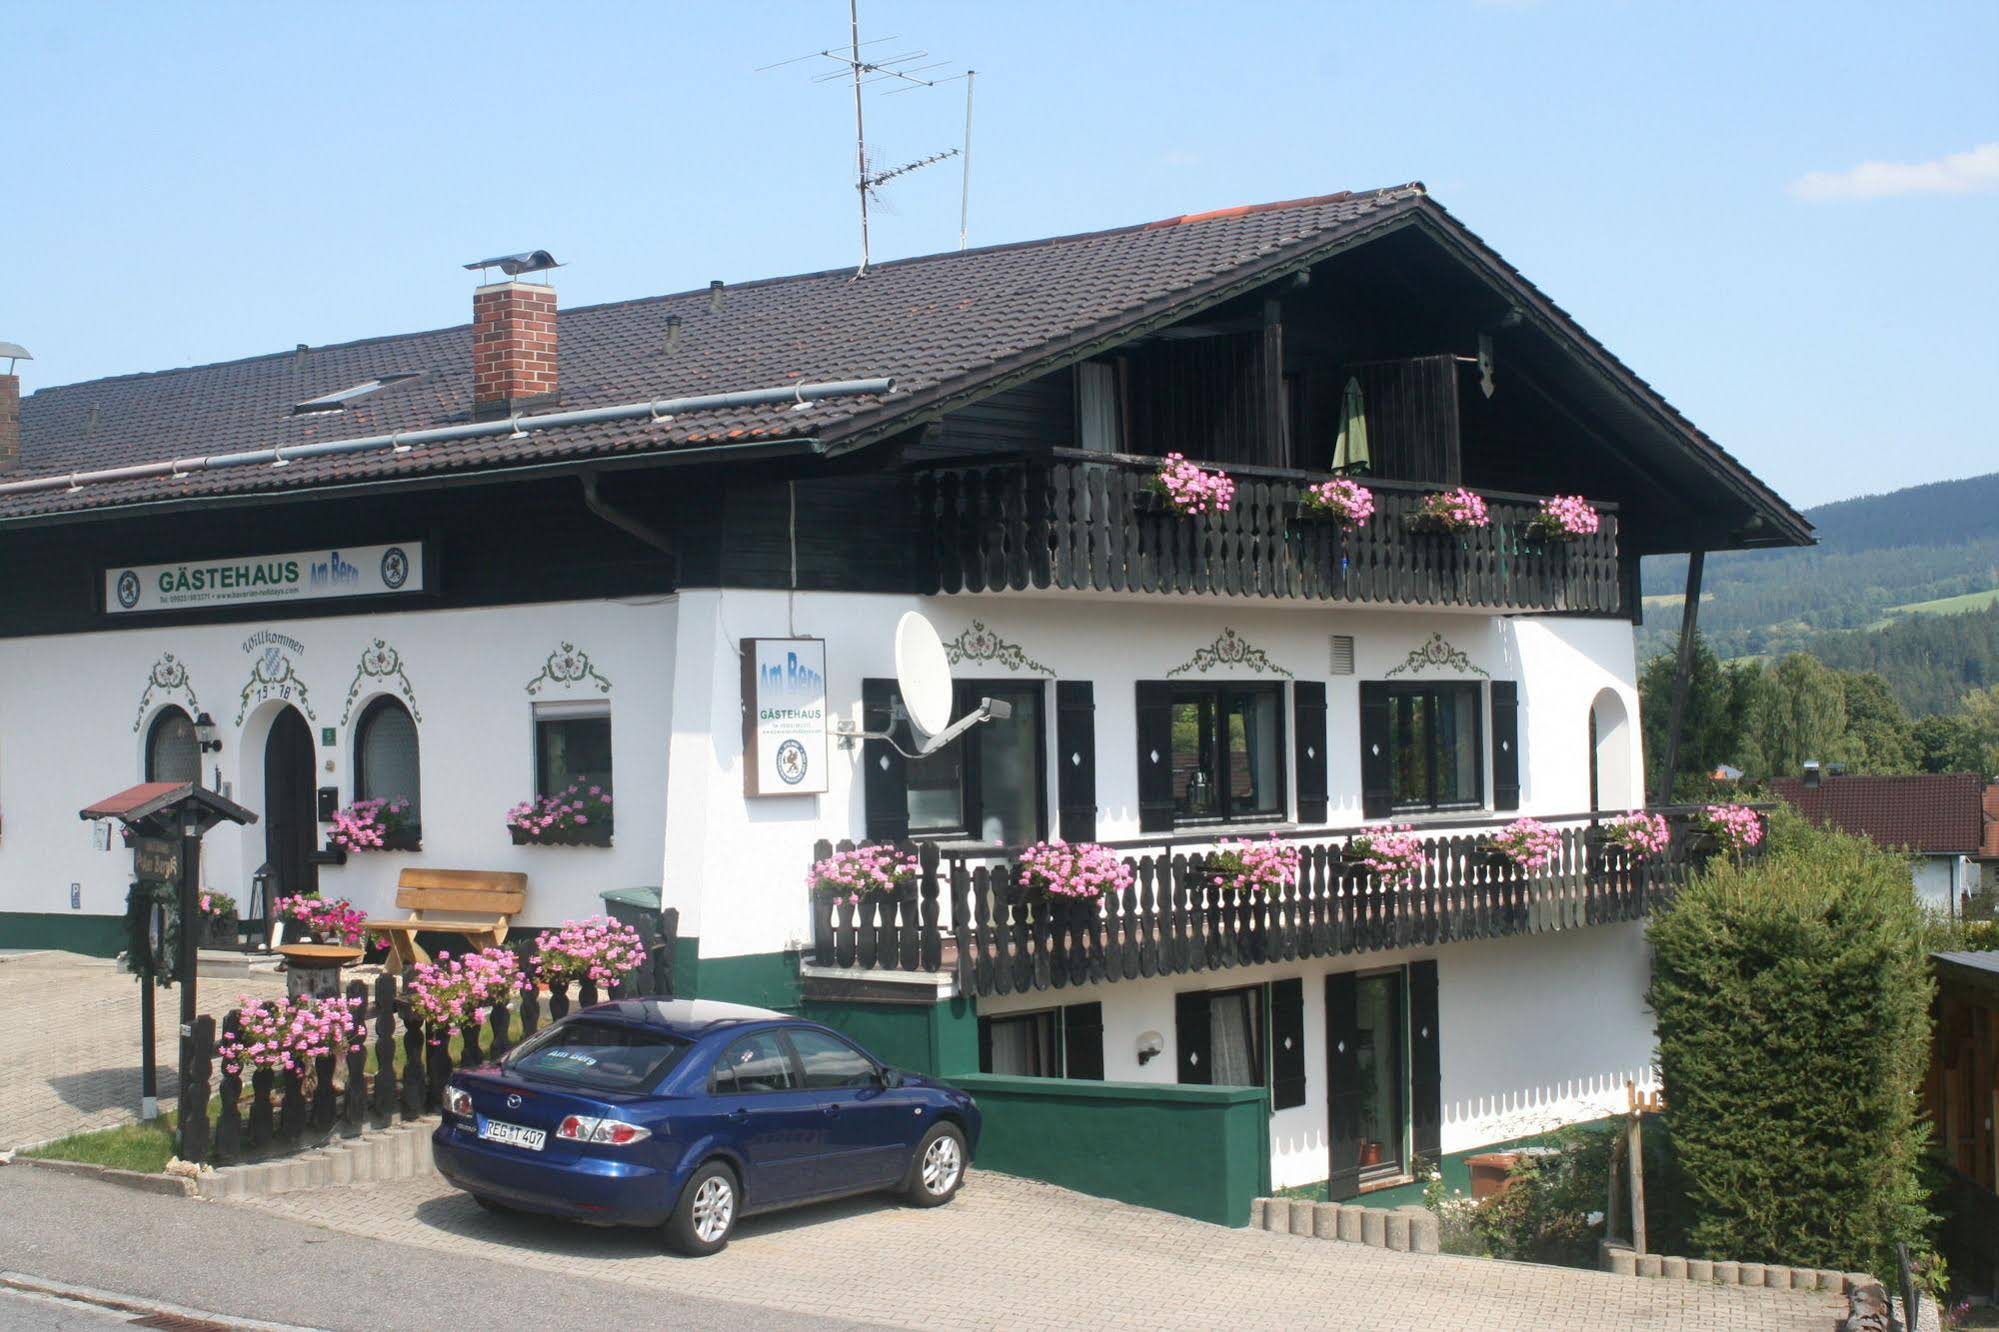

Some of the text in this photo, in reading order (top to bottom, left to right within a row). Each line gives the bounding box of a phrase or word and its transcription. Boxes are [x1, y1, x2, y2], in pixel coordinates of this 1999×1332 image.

[158, 560, 300, 594] GÄSTEHAUS
[310, 561, 329, 585] Am
[242, 629, 305, 656] Willkommen
[760, 663, 783, 694] Am
[760, 708, 822, 720] GÄSTEHAUS
[486, 1121, 508, 1138] REG
[514, 1127, 522, 1140] T
[523, 1130, 544, 1146] 407
